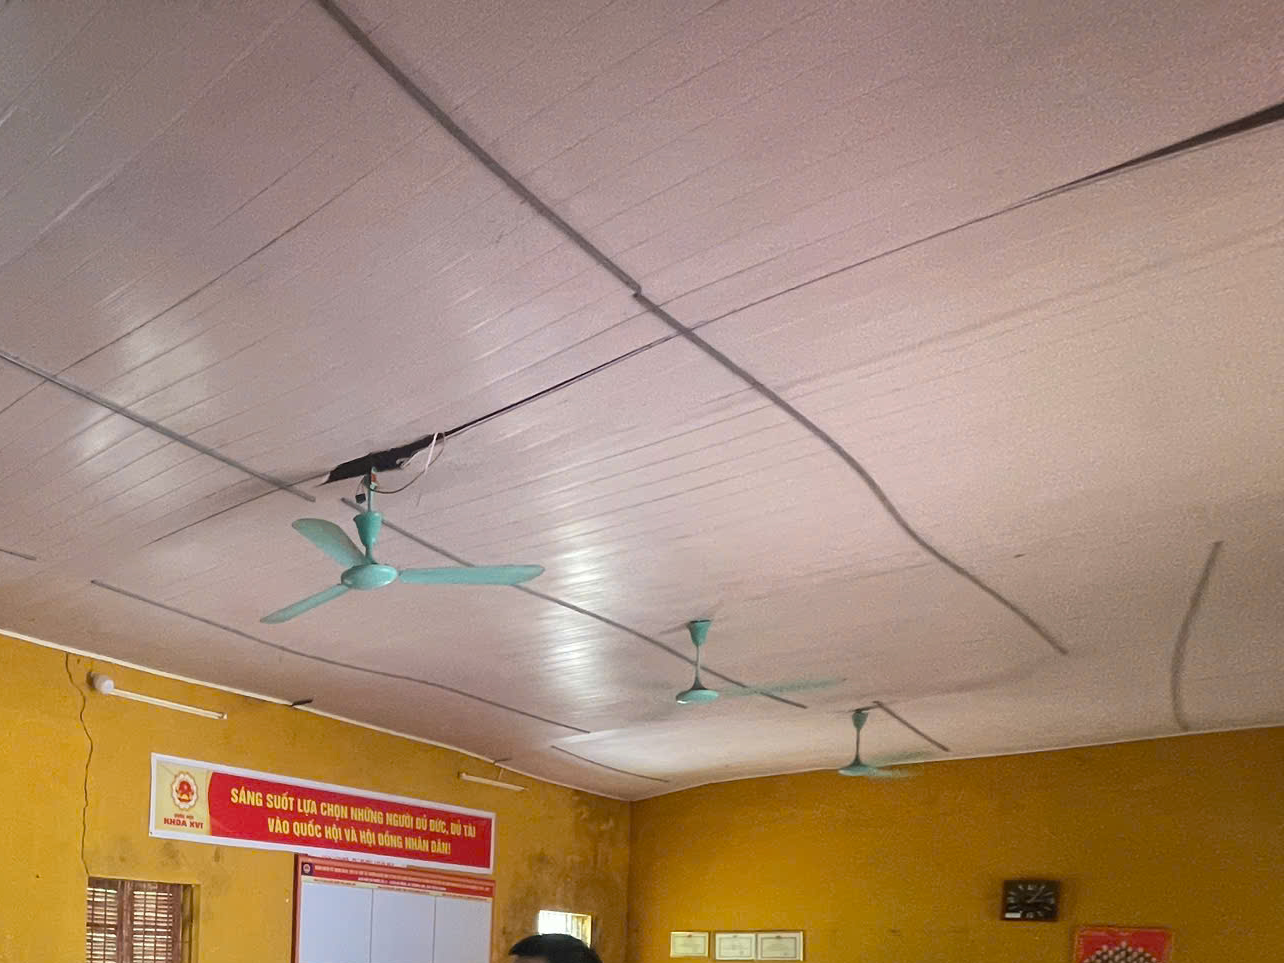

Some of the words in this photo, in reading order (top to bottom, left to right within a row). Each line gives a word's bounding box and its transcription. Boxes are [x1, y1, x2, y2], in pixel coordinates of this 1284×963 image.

[230, 786, 263, 807] SÁNG
[266, 792, 295, 811] SUỐT
[297, 798, 318, 817] LỰA
[320, 802, 348, 821] CHỌN
[350, 807, 384, 825] NHỮNG
[386, 812, 414, 830] NGƯỜI
[463, 823, 476, 838] TÀI
[267, 816, 290, 835] VÀO
[292, 819, 322, 838] QUỐC
[324, 823, 342, 843] HỘI
[344, 826, 358, 843] VÀ
[359, 829, 376, 847] HỘI
[377, 831, 404, 849] ĐỒNG
[404, 836, 429, 852] NHÂN
